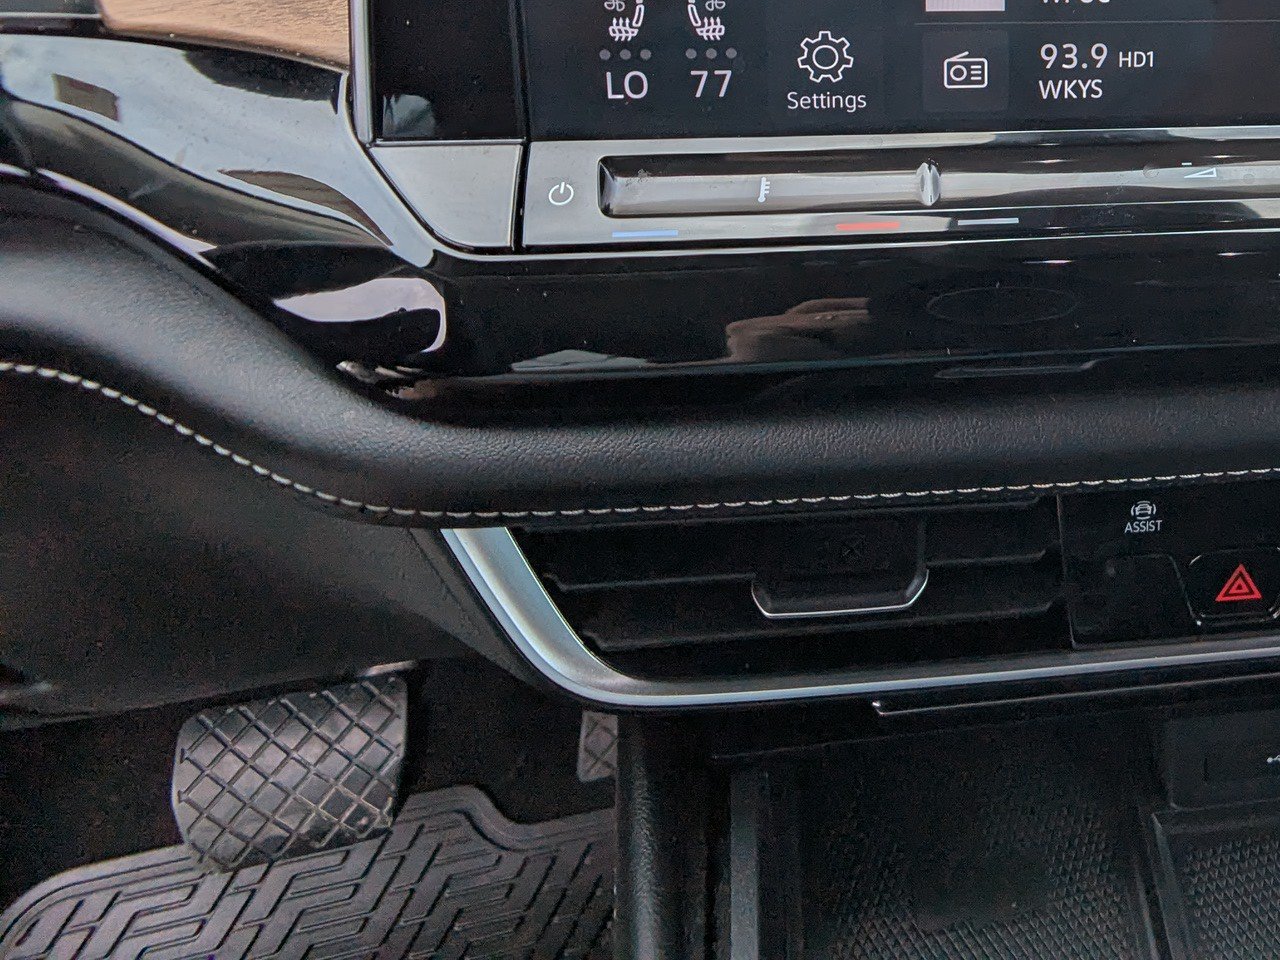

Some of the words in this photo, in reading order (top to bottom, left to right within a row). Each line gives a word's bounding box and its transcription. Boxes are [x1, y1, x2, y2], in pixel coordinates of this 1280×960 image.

[1040, 43, 1108, 70] 93.9
[1118, 50, 1155, 68] HD1
[605, 70, 649, 100] LO
[690, 69, 732, 98] 77
[1038, 79, 1104, 100] WKYS
[786, 91, 867, 113] Settings
[1124, 518, 1163, 534] ASSIST
